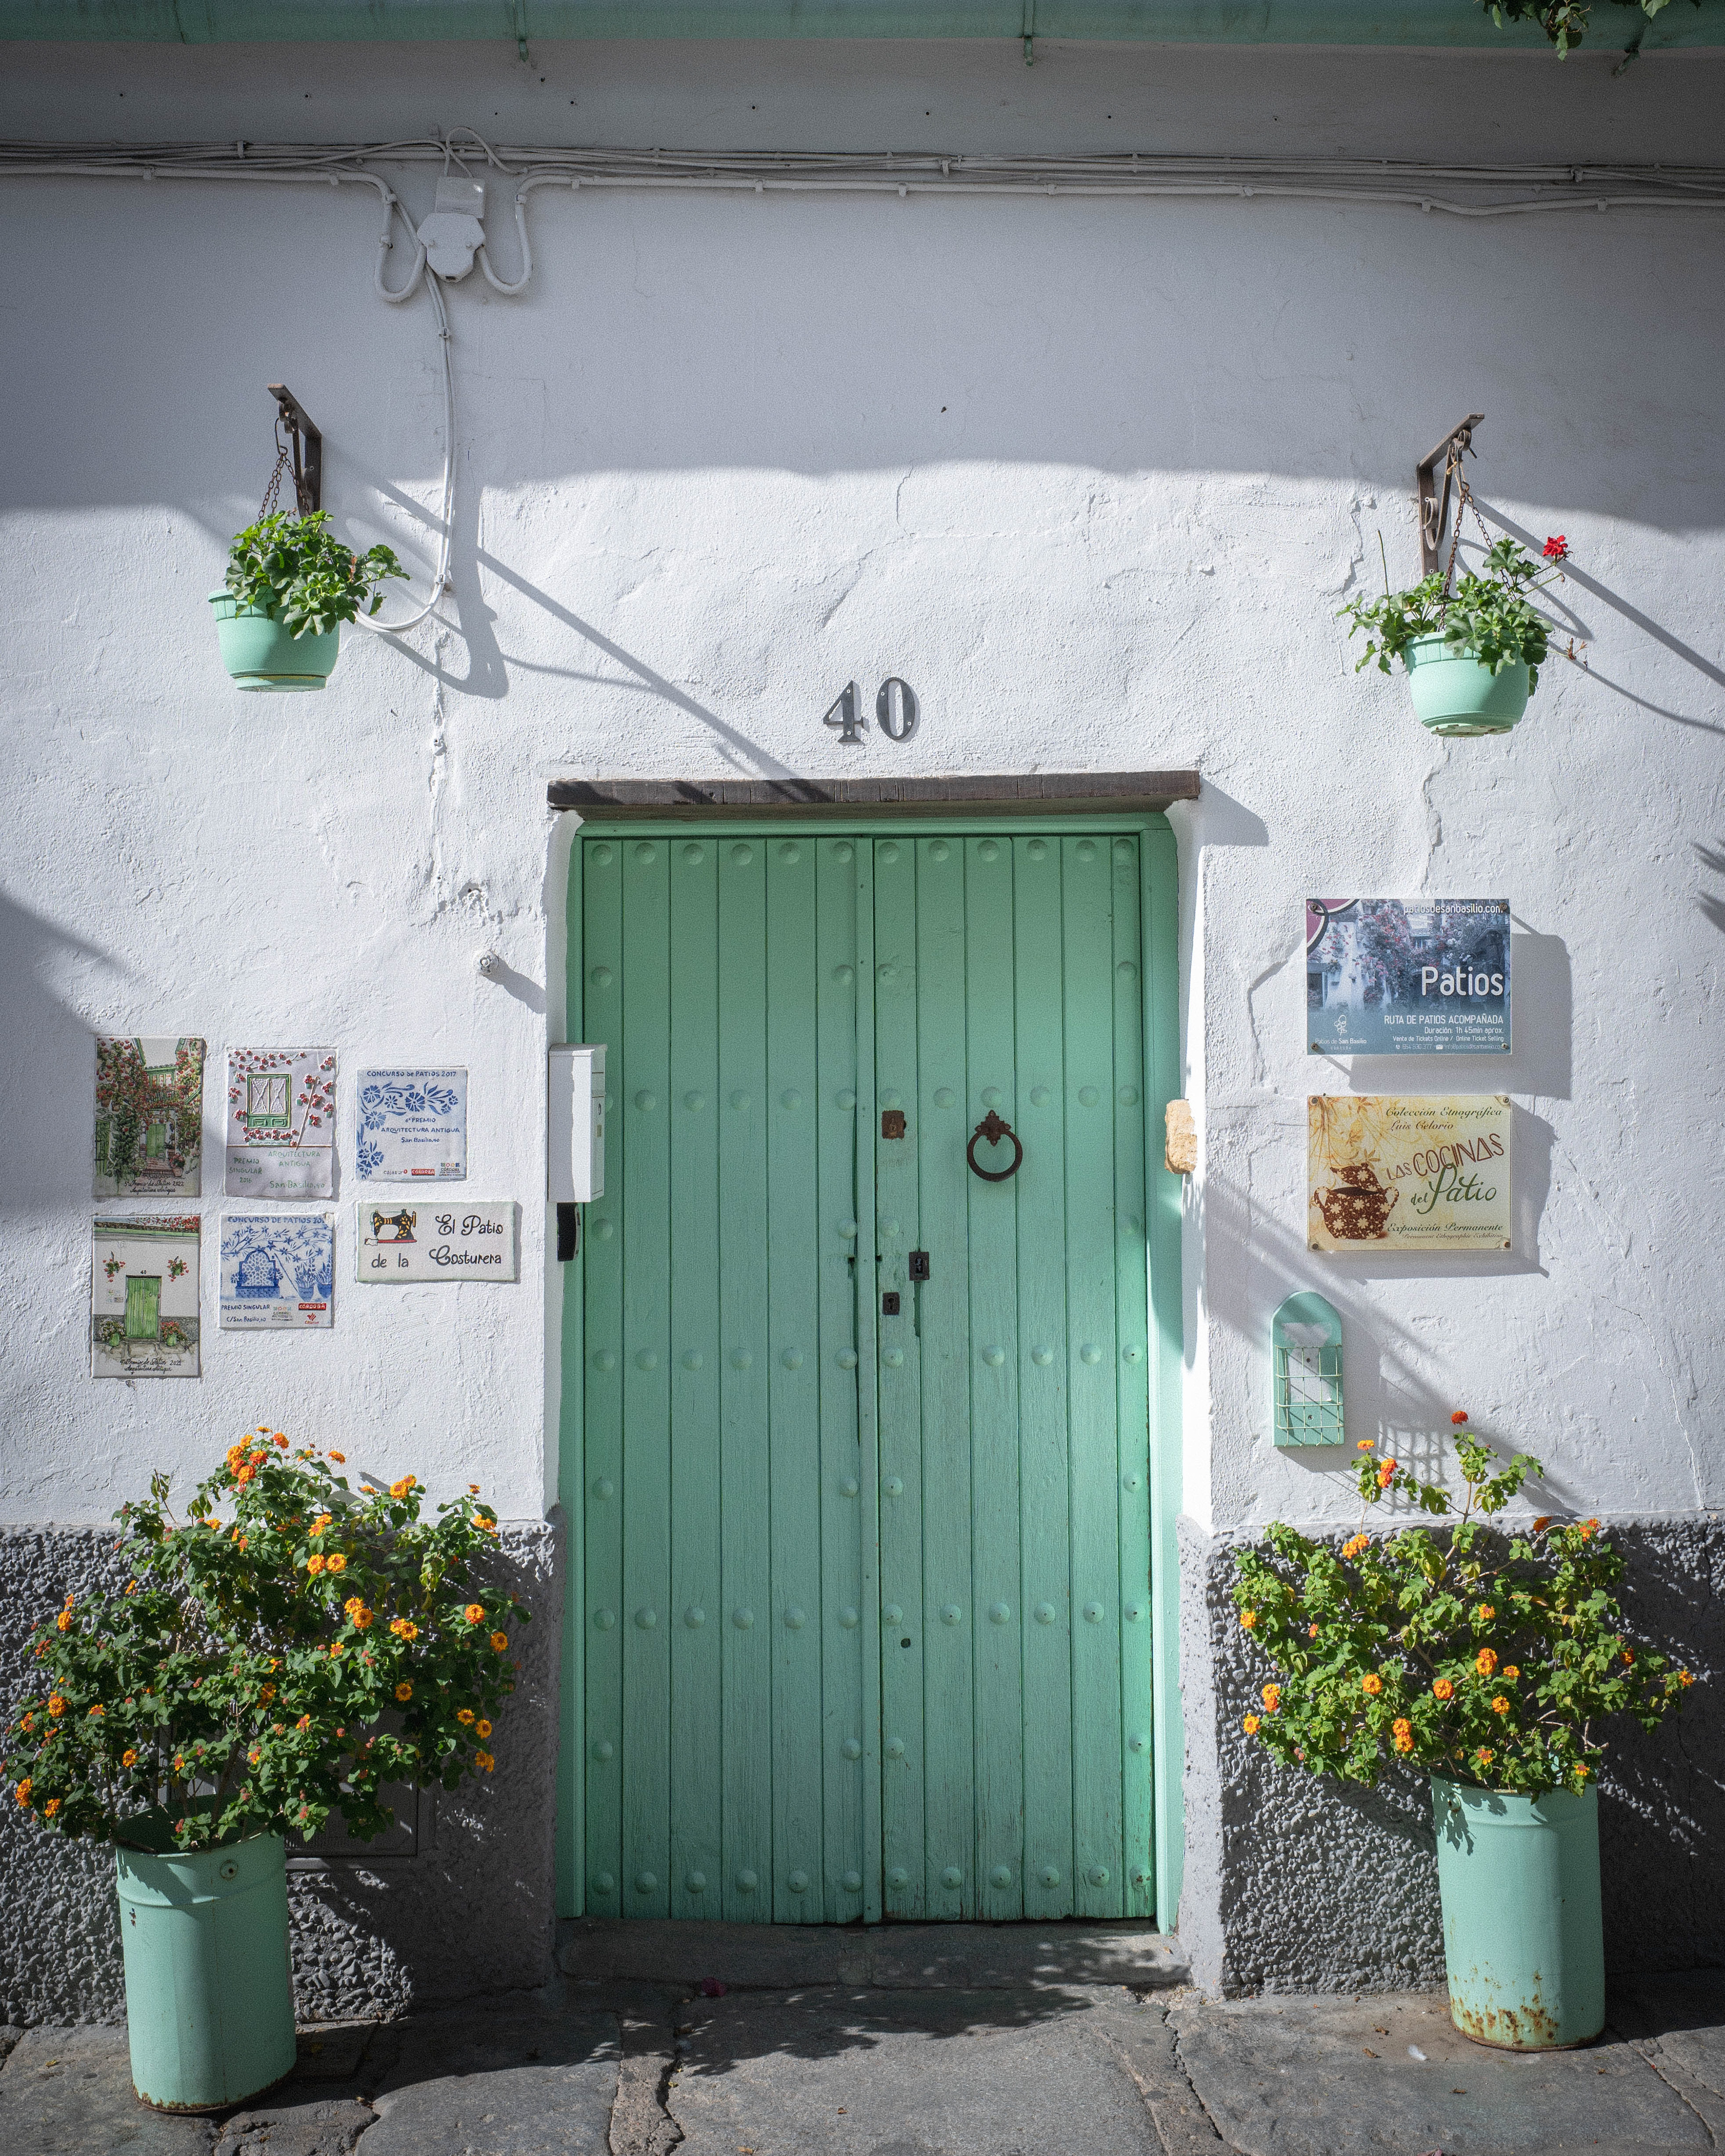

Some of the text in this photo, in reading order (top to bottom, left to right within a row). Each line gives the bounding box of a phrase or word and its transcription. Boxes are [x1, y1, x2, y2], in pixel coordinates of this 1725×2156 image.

[823, 677, 915, 742] 40
[1422, 966, 1503, 996] Patios
[1384, 1013, 1504, 1025] RUTA DE PATIOS ACOMPAÑADA
[1386, 1106, 1502, 1119] Colección Etnográfica
[1387, 1120, 1453, 1131] Luis Celorio
[1386, 1133, 1504, 1180] LAS COCINAS
[1411, 1163, 1497, 1214] del Patio
[435, 1214, 503, 1236] El Patio
[1388, 1222, 1503, 1234] Exposición Permanente
[372, 1245, 501, 1268] de la Costurera
